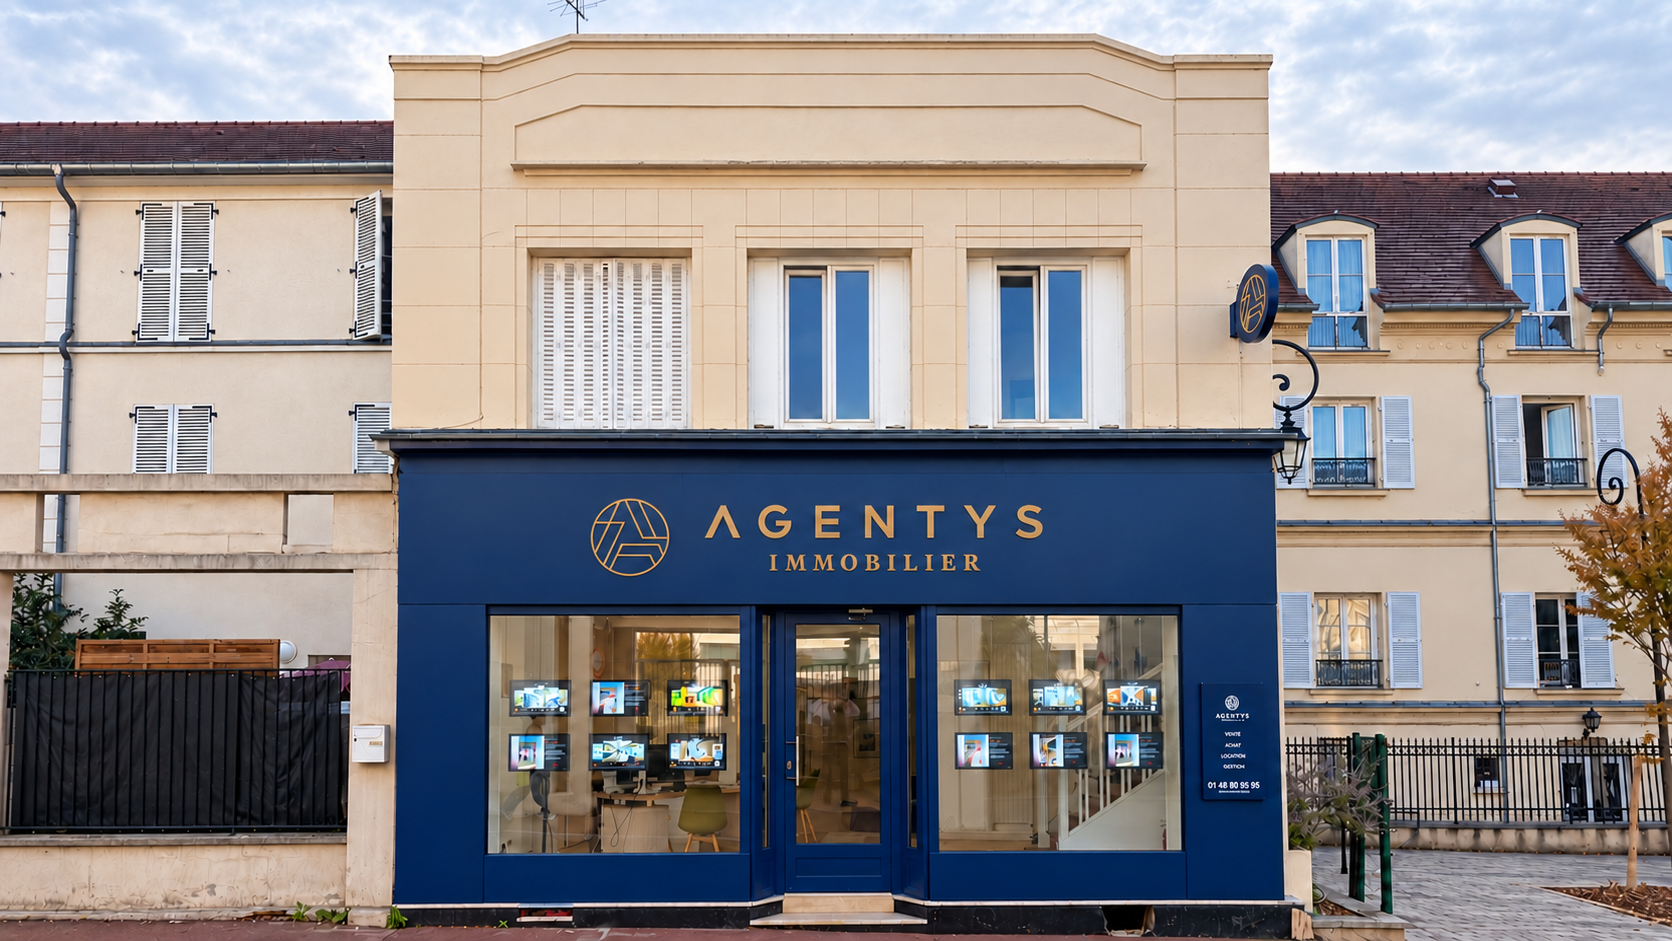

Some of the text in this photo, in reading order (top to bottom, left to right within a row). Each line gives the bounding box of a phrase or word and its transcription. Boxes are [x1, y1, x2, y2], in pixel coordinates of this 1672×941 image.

[705, 504, 1044, 539] AGENTYS
[769, 553, 981, 572] IMMOBILIER
[1207, 781, 1216, 789] 01
[1218, 781, 1228, 789] 48
[1229, 781, 1239, 789] 80
[1250, 781, 1260, 789] 95
